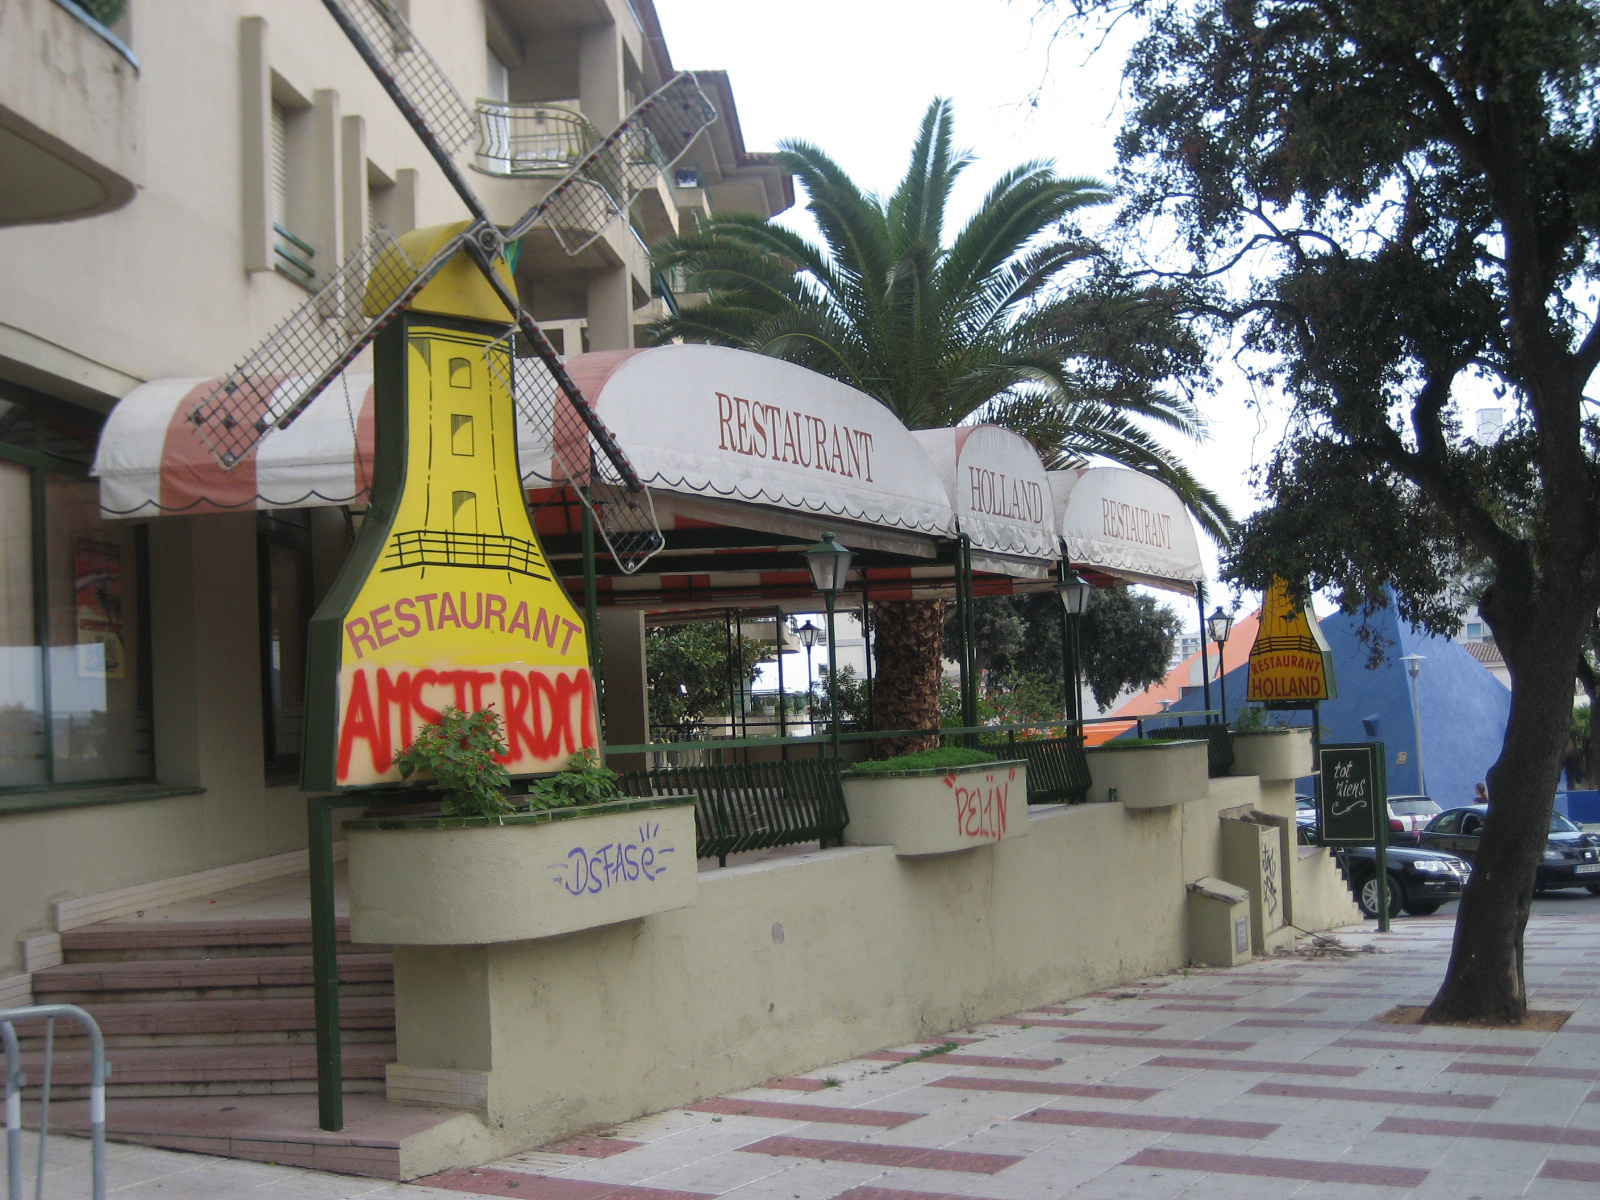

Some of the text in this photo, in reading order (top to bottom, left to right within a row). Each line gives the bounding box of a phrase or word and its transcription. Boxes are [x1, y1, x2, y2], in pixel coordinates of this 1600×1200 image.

[715, 392, 874, 484] RESTAURANT
[968, 466, 1044, 525] HOLLAND
[1102, 498, 1172, 550] RESTAURANT
[345, 592, 583, 659] RESTAURANT
[1251, 655, 1321, 675] RESTAURANT
[1252, 676, 1321, 698] HOLLAND
[1334, 761, 1353, 778] tot
